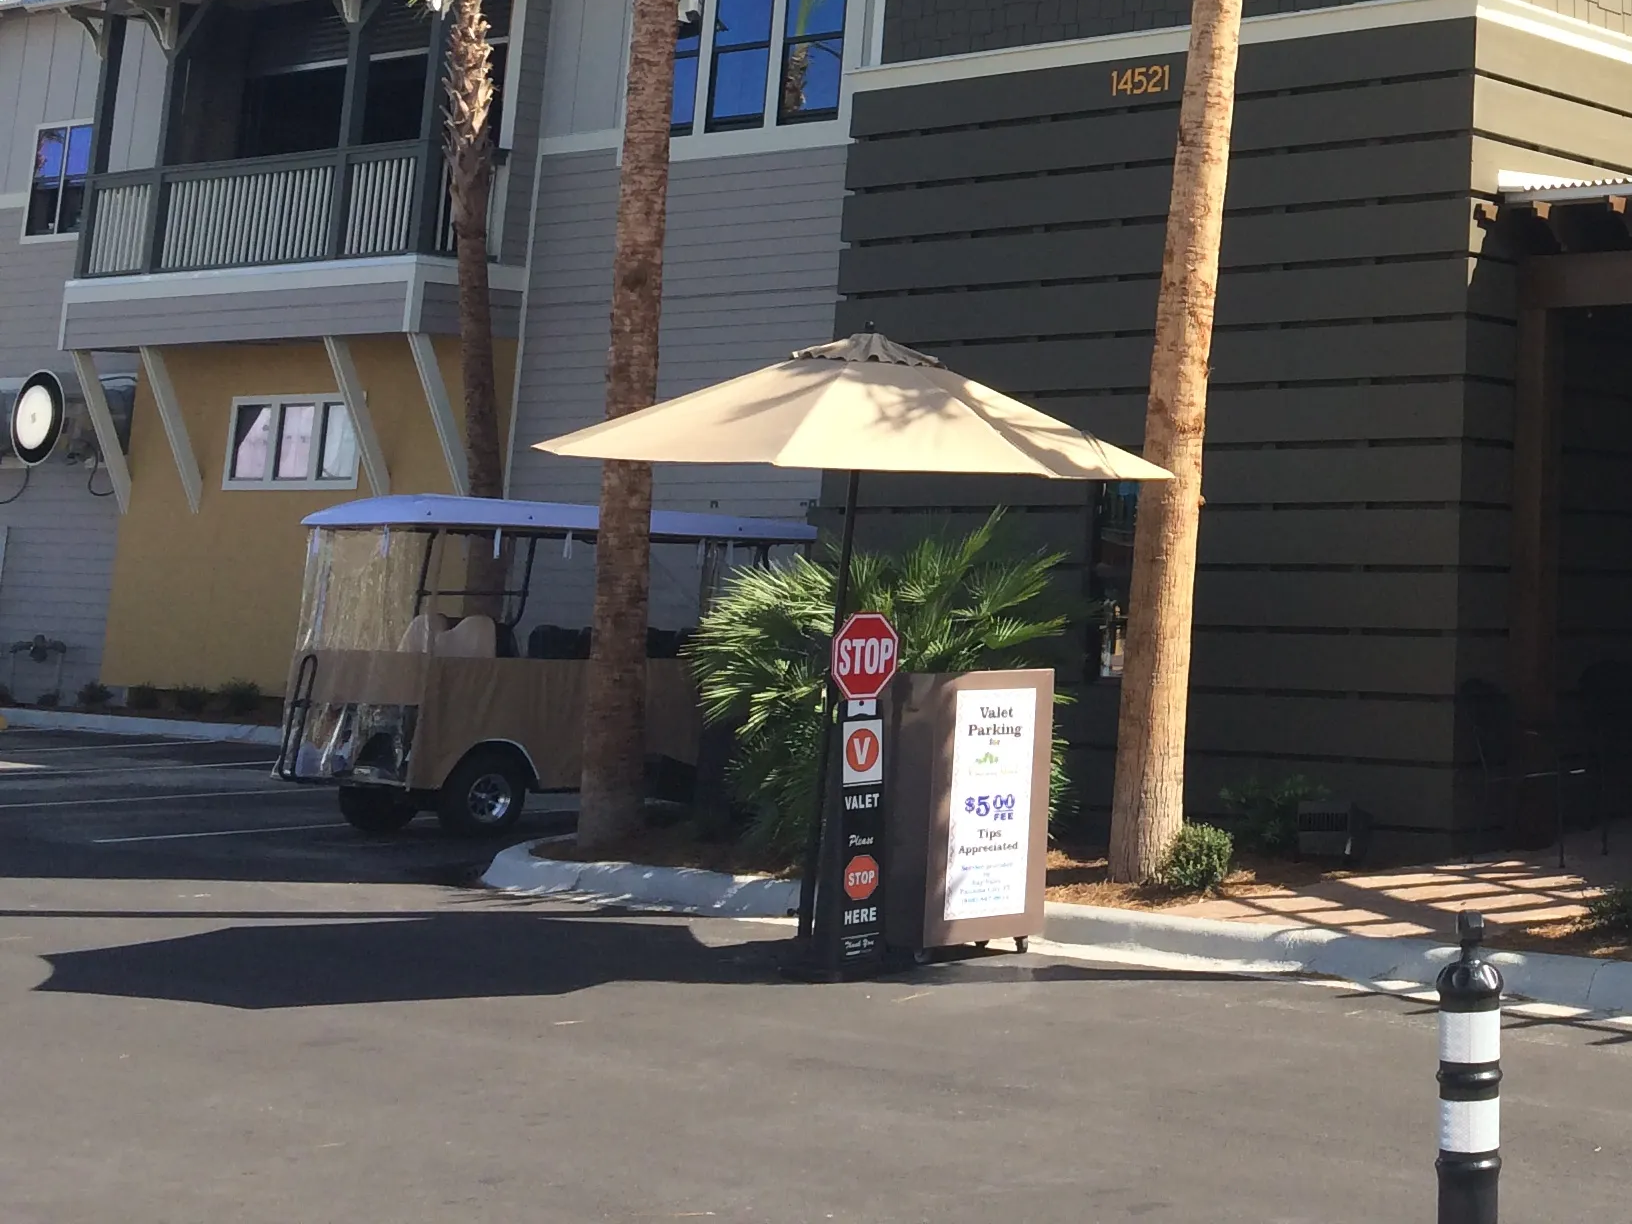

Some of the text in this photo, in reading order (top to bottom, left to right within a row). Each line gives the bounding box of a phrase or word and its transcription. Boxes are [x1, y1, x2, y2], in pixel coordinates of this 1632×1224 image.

[1111, 65, 1170, 96] 14521
[838, 637, 894, 676] STOP
[980, 706, 1014, 719] Valet
[968, 723, 1023, 737] Parking
[989, 738, 1001, 746] for
[852, 737, 871, 765] V
[845, 793, 879, 811] VALET
[994, 812, 1014, 821] FEE
[848, 833, 874, 848] Please
[977, 828, 1002, 840] Tips
[959, 841, 1019, 856] Appreciated
[848, 870, 875, 886] STOP
[844, 906, 877, 926] HERE
